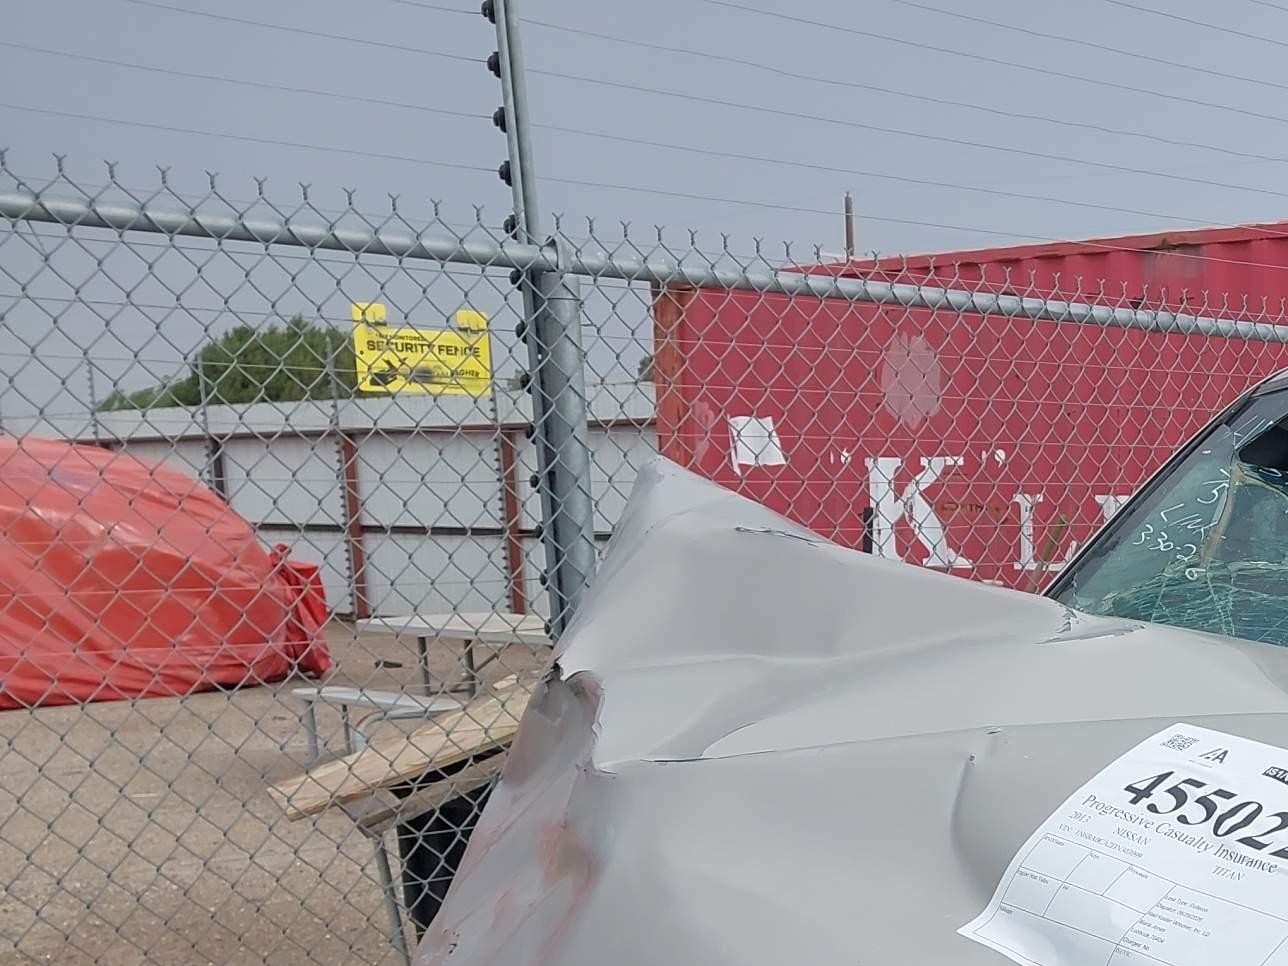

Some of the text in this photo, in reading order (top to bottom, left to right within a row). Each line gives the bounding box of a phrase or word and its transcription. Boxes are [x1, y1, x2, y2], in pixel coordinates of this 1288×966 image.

[366, 340, 435, 354] SEURITY
[1067, 810, 1092, 824] 2013
[1111, 826, 1152, 847] NISSAN
[1211, 864, 1246, 881] TITAN
[1081, 794, 1155, 830] Progressive
[1155, 821, 1214, 854] Casualty
[1213, 842, 1279, 874] Insurance
